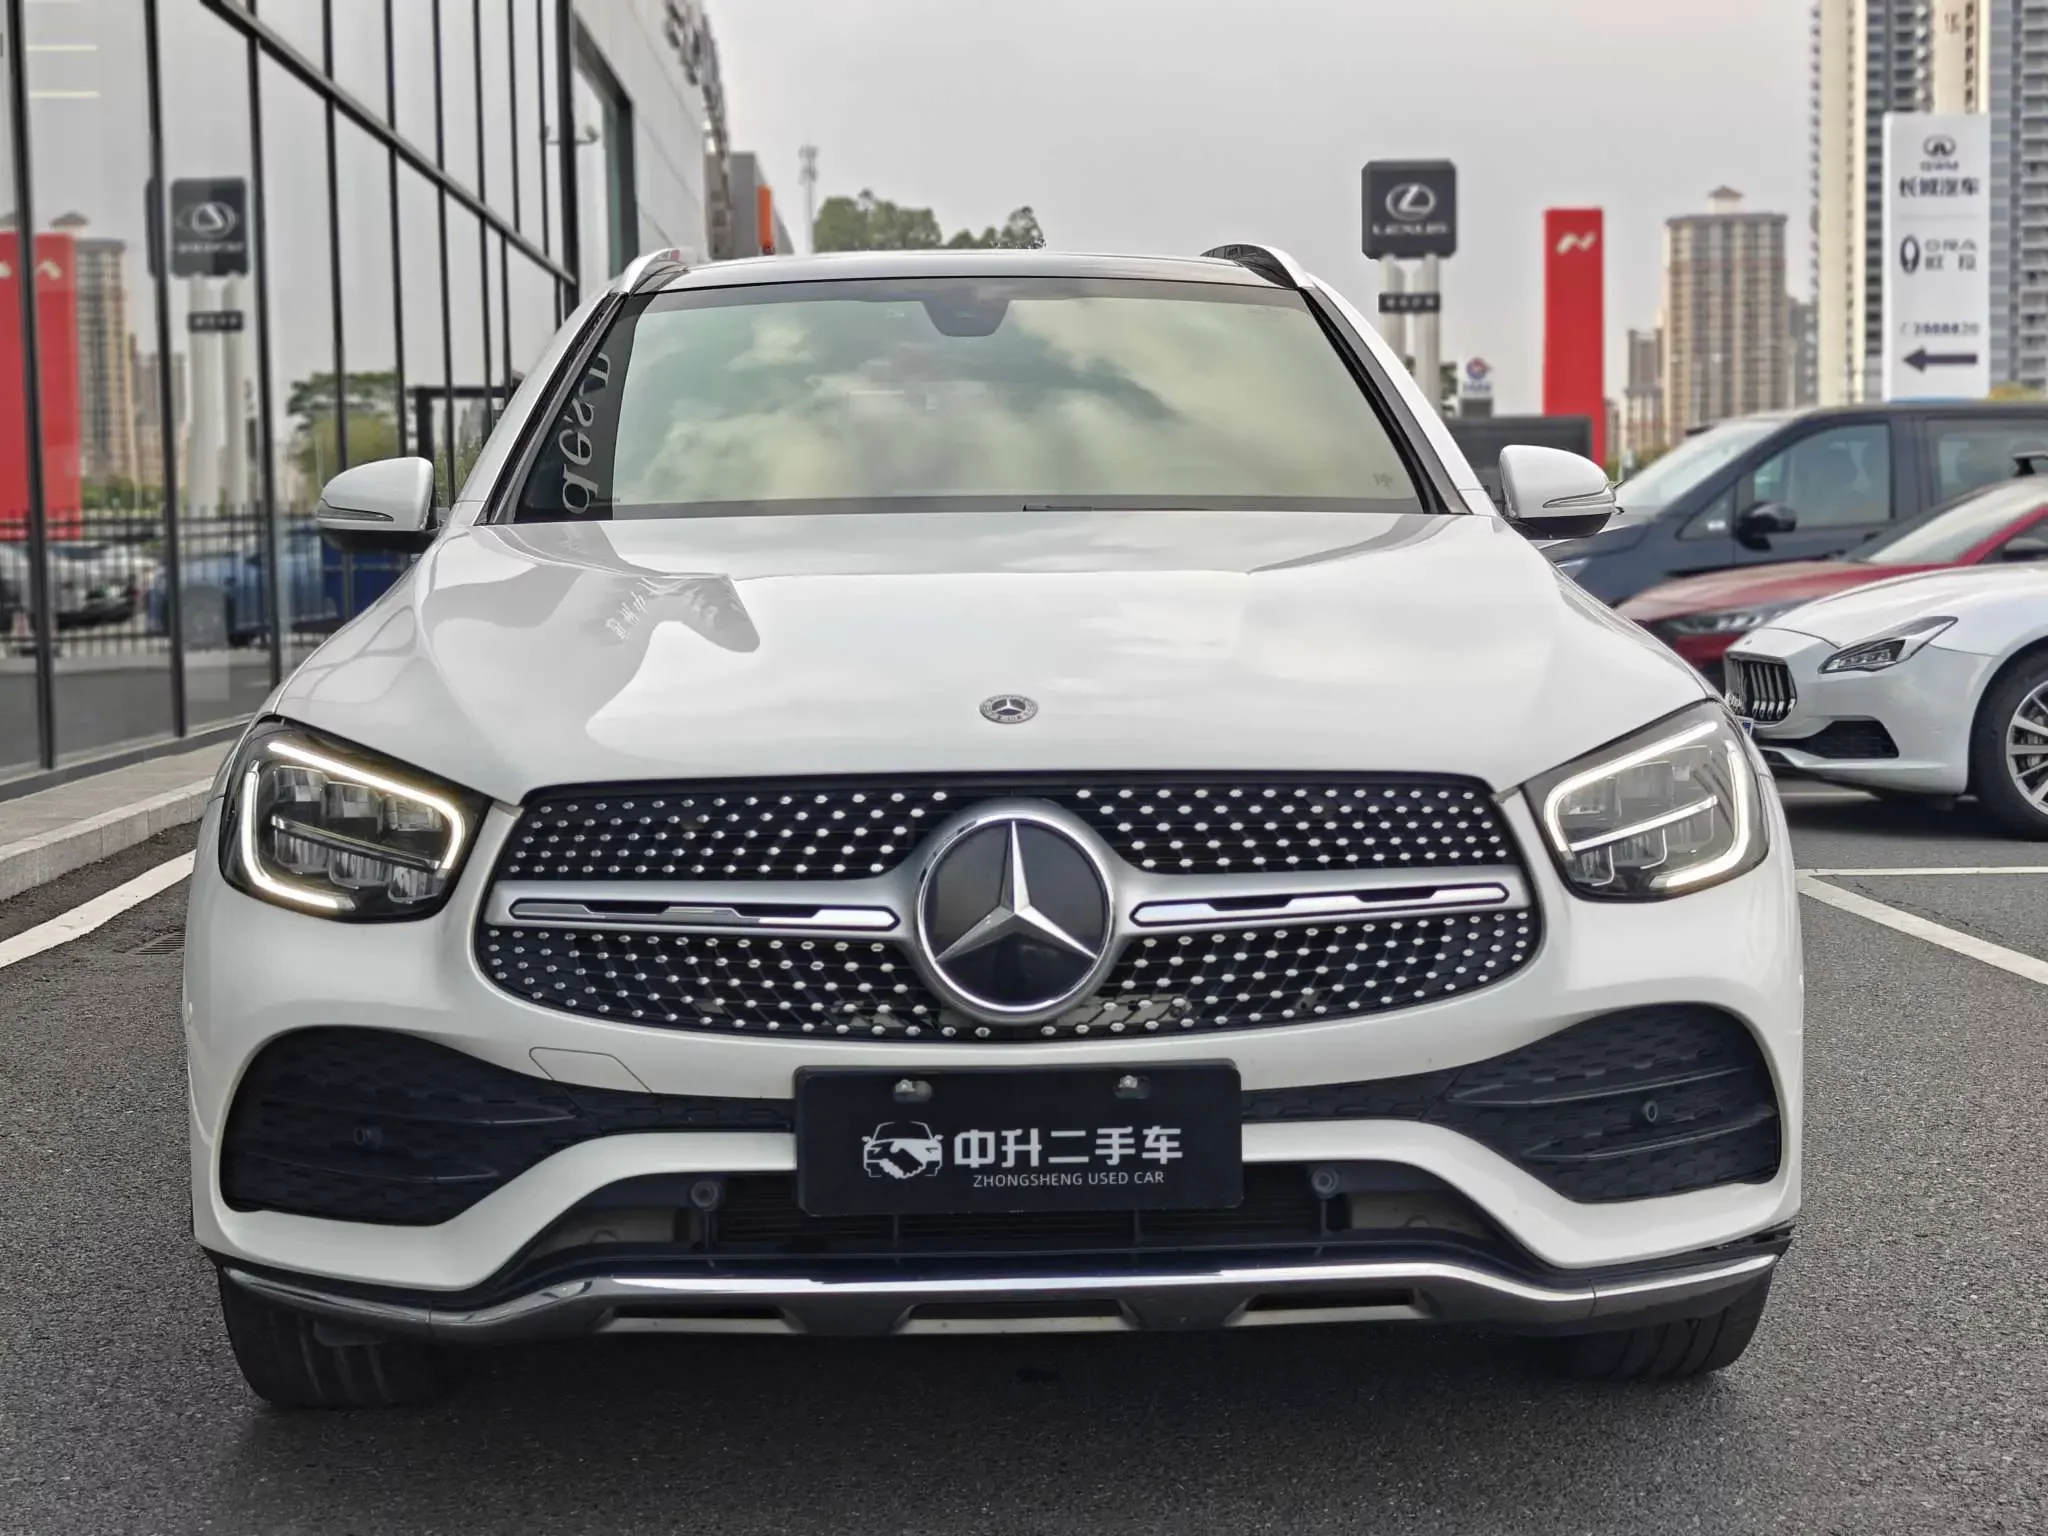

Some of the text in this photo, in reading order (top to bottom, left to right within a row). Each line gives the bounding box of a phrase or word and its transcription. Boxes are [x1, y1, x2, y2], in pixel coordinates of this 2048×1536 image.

[954, 1126, 1183, 1168] 中升二手车
[973, 1171, 1165, 1188] ZHONGSHENG USED CAR
